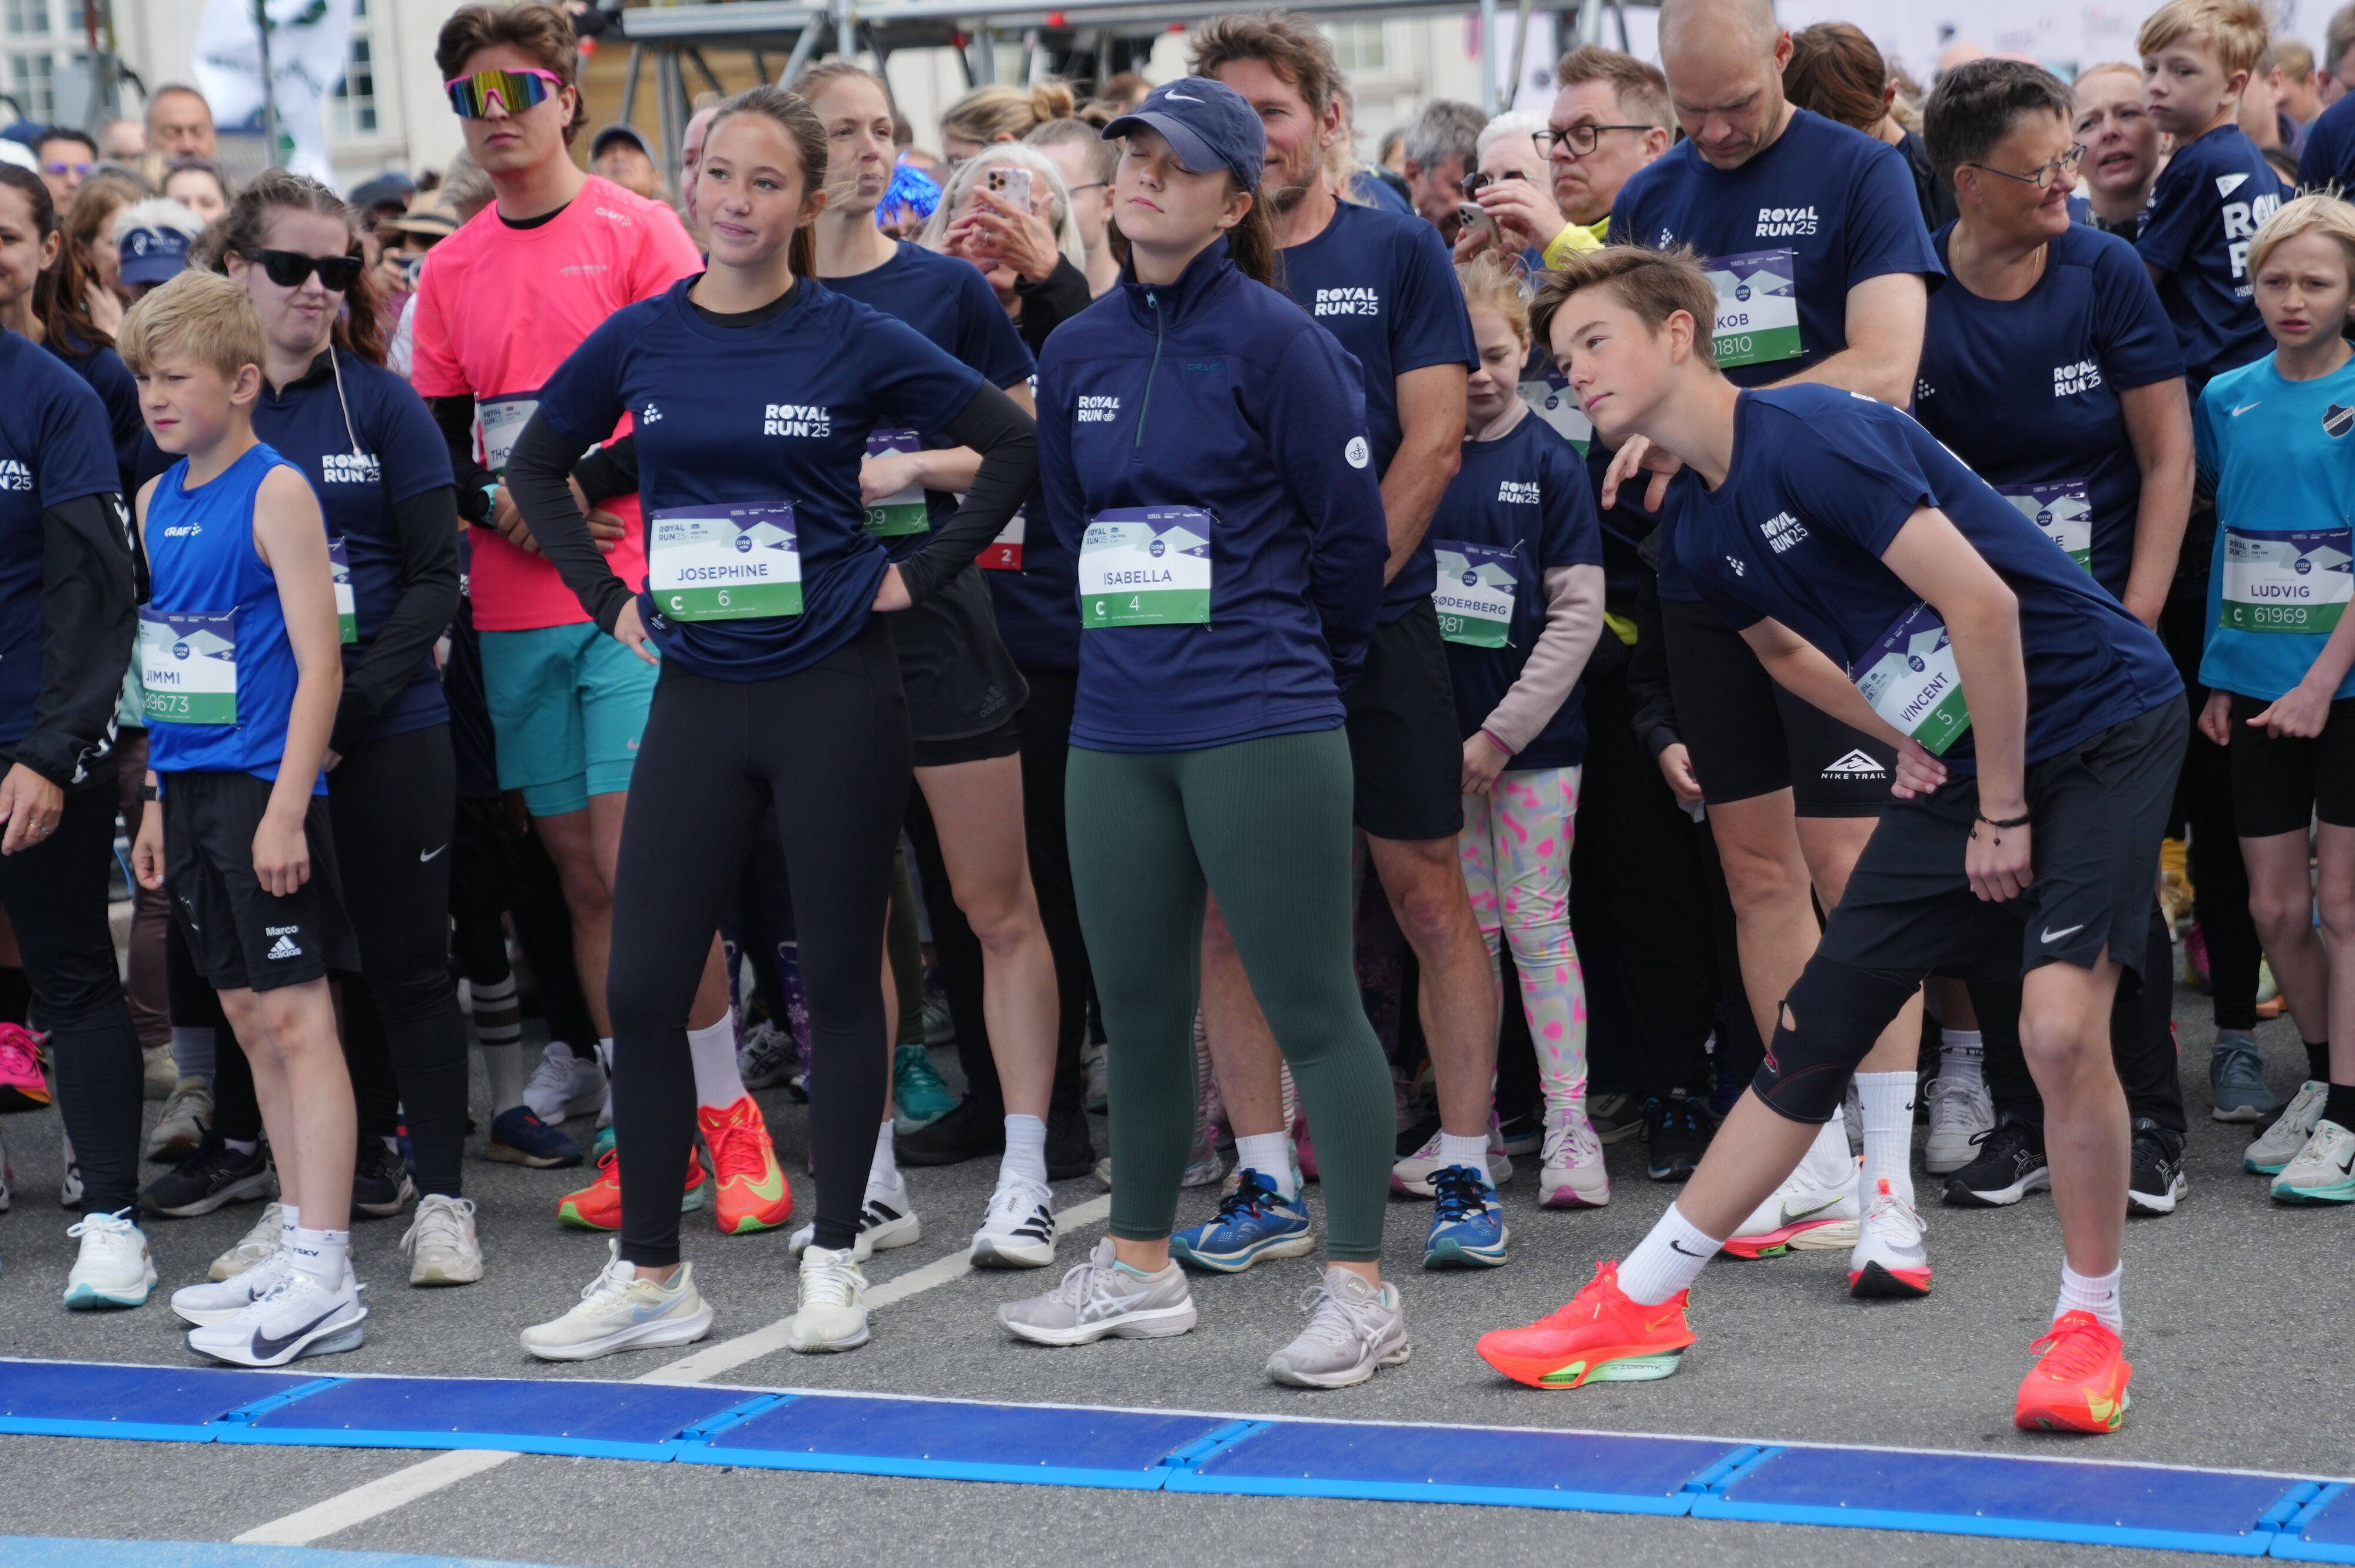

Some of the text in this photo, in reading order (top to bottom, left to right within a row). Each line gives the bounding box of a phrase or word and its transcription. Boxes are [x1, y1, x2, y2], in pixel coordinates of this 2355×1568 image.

[1758, 206, 1818, 222] ROYAL
[1316, 287, 1378, 302] ROYAL
[2054, 358, 2097, 382] ROYAL
[1078, 396, 1120, 409] ROYAL
[483, 408, 502, 418] ROYAL
[765, 404, 830, 421] ROYAL
[1077, 409, 1103, 422] RUN
[2325, 408, 2353, 430] SPARTA
[1500, 481, 1541, 493] ROYAL
[659, 524, 685, 533] ROYAL
[1087, 527, 1106, 536] ROYAL
[1760, 511, 1797, 539] ROYAL
[2229, 540, 2247, 550] ROYAL
[1001, 549, 1011, 562] 2
[676, 563, 768, 582] JOSEPHINE
[1103, 569, 1172, 585] ISABELLA
[2251, 585, 2310, 597] LUDVIG
[671, 590, 729, 610] C 6
[1096, 596, 1140, 615] C 4
[1432, 596, 1507, 615] SØDERBERG
[2234, 607, 2307, 623] C 61969
[1910, 657, 1921, 668] one
[145, 669, 180, 685] JIMMI
[145, 692, 189, 713] 89673
[1900, 672, 1949, 722] VINCENT
[1936, 709, 1952, 725] 5
[265, 925, 299, 937] Marco
[267, 946, 302, 961] adidas
[1672, 1087, 1686, 1095] NIKE
